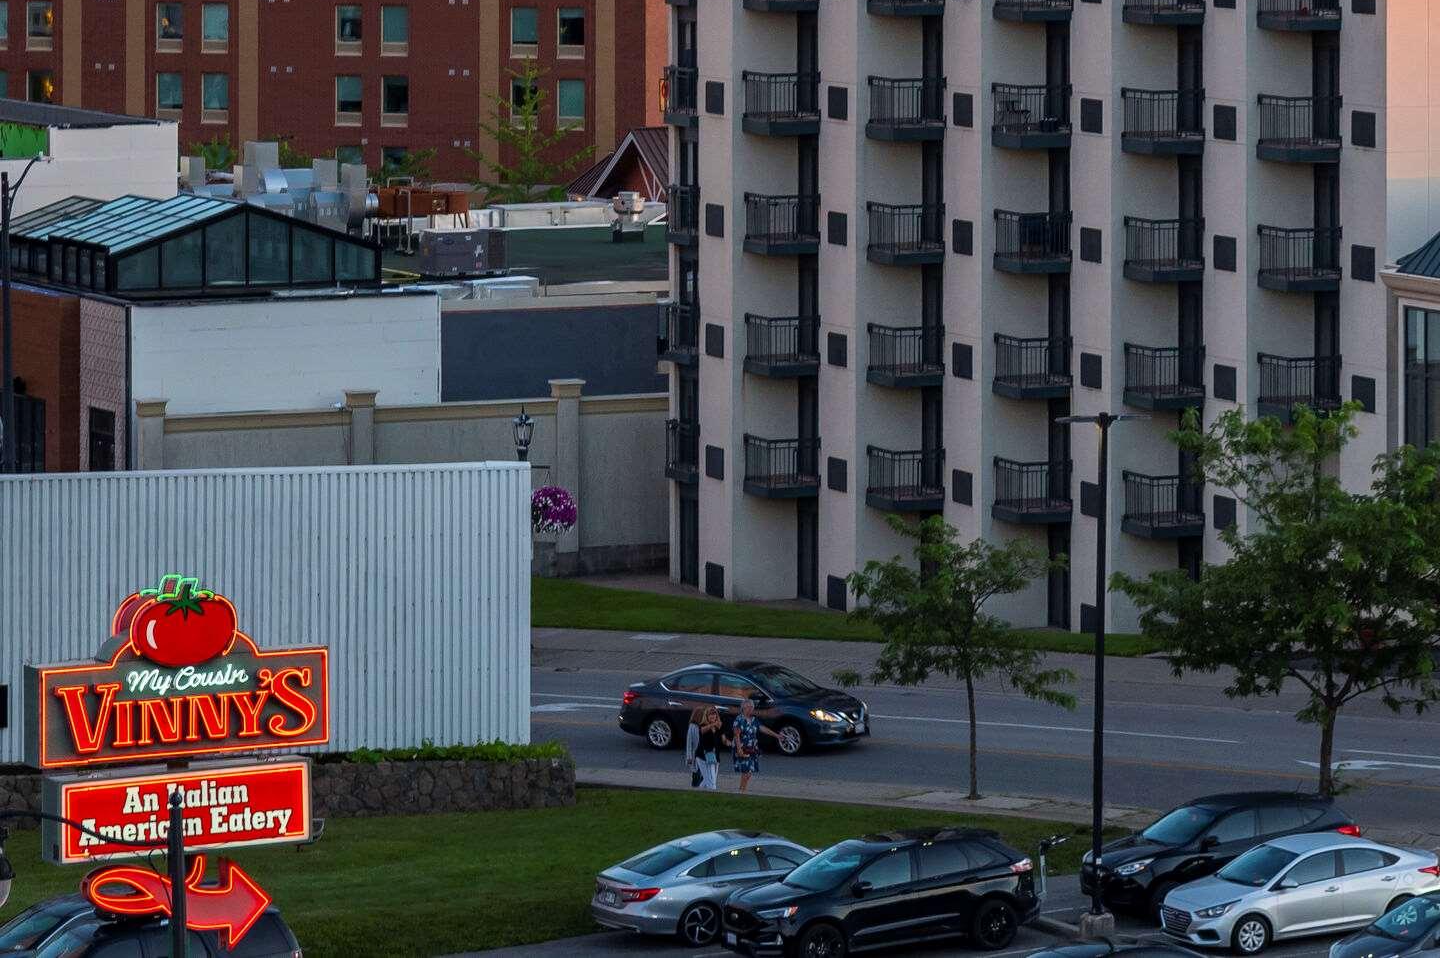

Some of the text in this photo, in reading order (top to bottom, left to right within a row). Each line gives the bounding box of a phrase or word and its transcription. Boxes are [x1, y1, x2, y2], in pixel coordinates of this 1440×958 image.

[126, 664, 249, 696] My Cousin
[54, 666, 318, 755] VINNY'S
[123, 786, 160, 814] An
[78, 806, 292, 847] Americn Eatery
